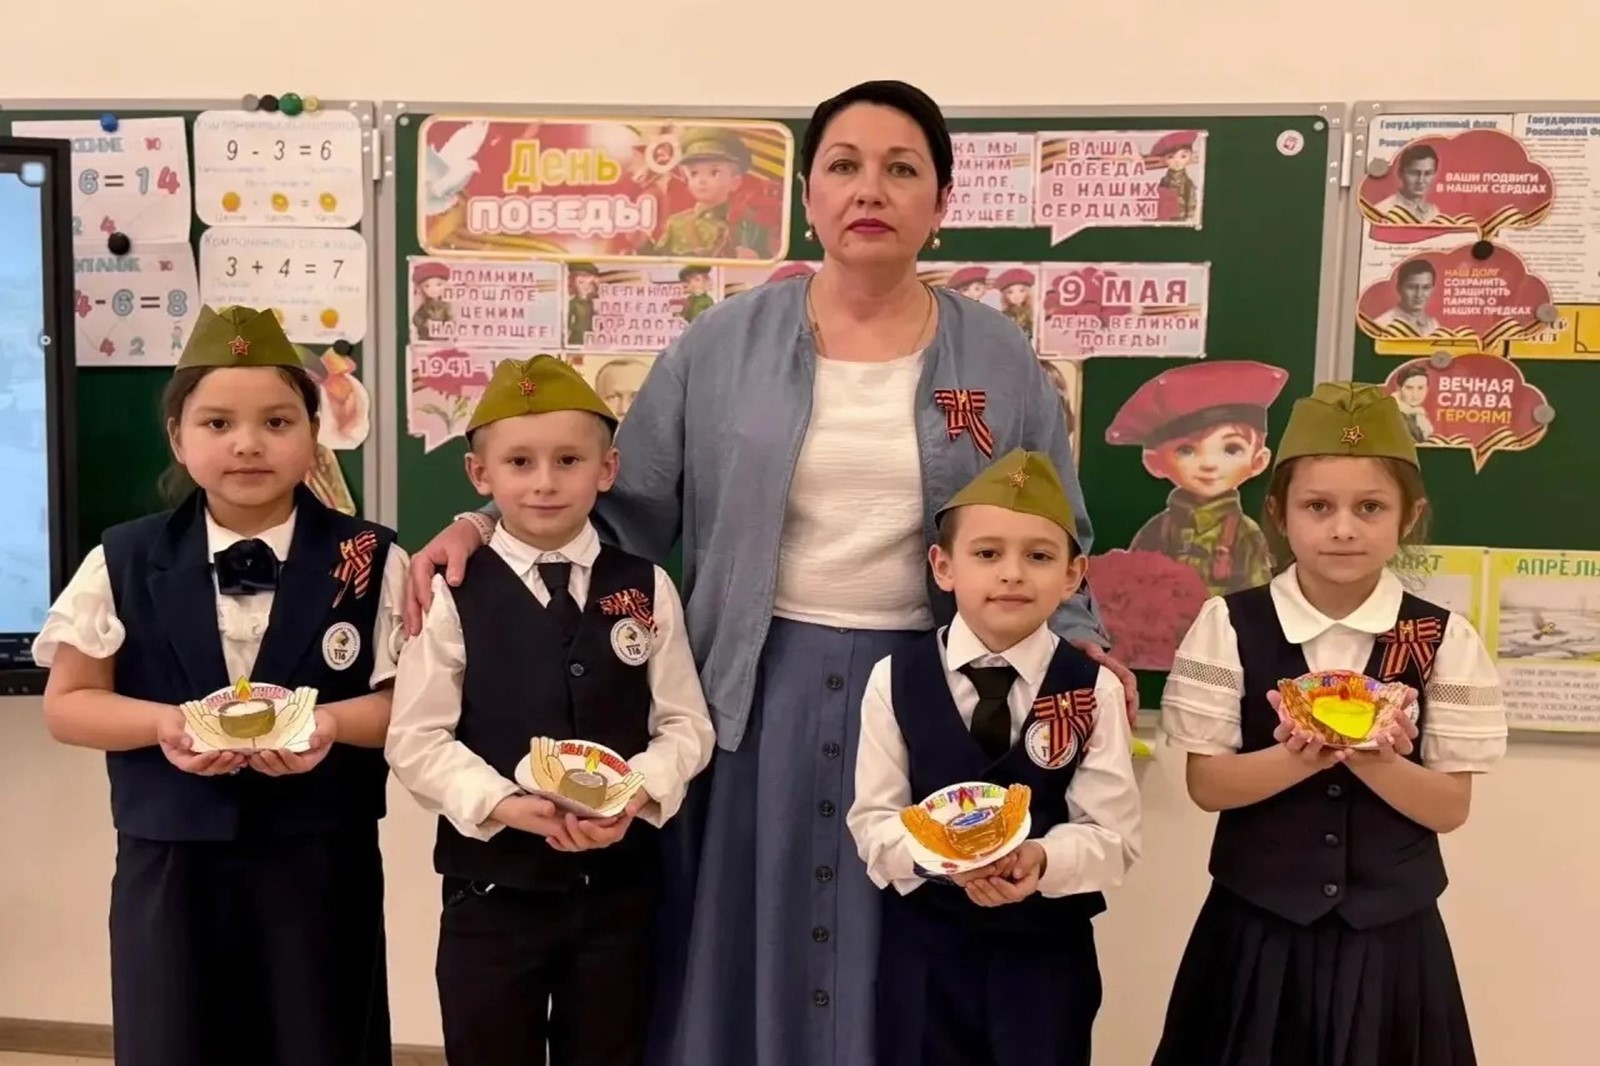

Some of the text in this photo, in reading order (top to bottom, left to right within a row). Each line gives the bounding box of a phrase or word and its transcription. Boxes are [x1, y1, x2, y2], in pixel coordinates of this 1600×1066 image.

[227, 140, 238, 160] 9
[274, 140, 285, 160] 3
[320, 140, 332, 160] 6
[953, 142, 1017, 153] КА МЫ
[1069, 141, 1132, 156] ВАША
[504, 140, 621, 192] День
[958, 160, 1011, 170] МНИМ
[1055, 162, 1144, 177] ПОБЕДА
[1445, 172, 1539, 183] ВАШИ ПОДВИГИ
[1053, 183, 1157, 197] В НАШИХ
[1436, 183, 1547, 195] В НАШИХ СЕРДЦАХ
[948, 193, 1027, 204] АС ЕСТЬ
[470, 196, 656, 238] ПОБЕДЫ
[951, 210, 1015, 221] ДУЩЕЕ
[1042, 203, 1156, 219] СЕРДЦАХ!
[226, 257, 238, 276] 3
[278, 258, 290, 278] 4
[333, 260, 344, 279] 7
[1445, 268, 1500, 277] НАШ ДОЛГ
[453, 270, 534, 283] ПОМНИМ
[1443, 278, 1507, 287] СОХРАНИТЬ
[444, 288, 536, 301] ПРОШЛОЕ
[1062, 279, 1187, 303] 9 МАЯ
[1443, 287, 1511, 296] И ЗАЩИТИТЬ
[112, 289, 134, 316] 6
[167, 289, 187, 317] 8
[1443, 297, 1497, 306] ПАМЯТЬ О
[461, 307, 525, 319] ЦЕНИМ
[1442, 306, 1531, 315] НАШИХ ПРЕДКАХ
[1051, 317, 1100, 330] ДЕНЬ
[1438, 376, 1514, 393] ВЕЧНАЯ
[1437, 393, 1512, 409] СЛАВА
[1436, 408, 1512, 424] ГЕРОЯМ!
